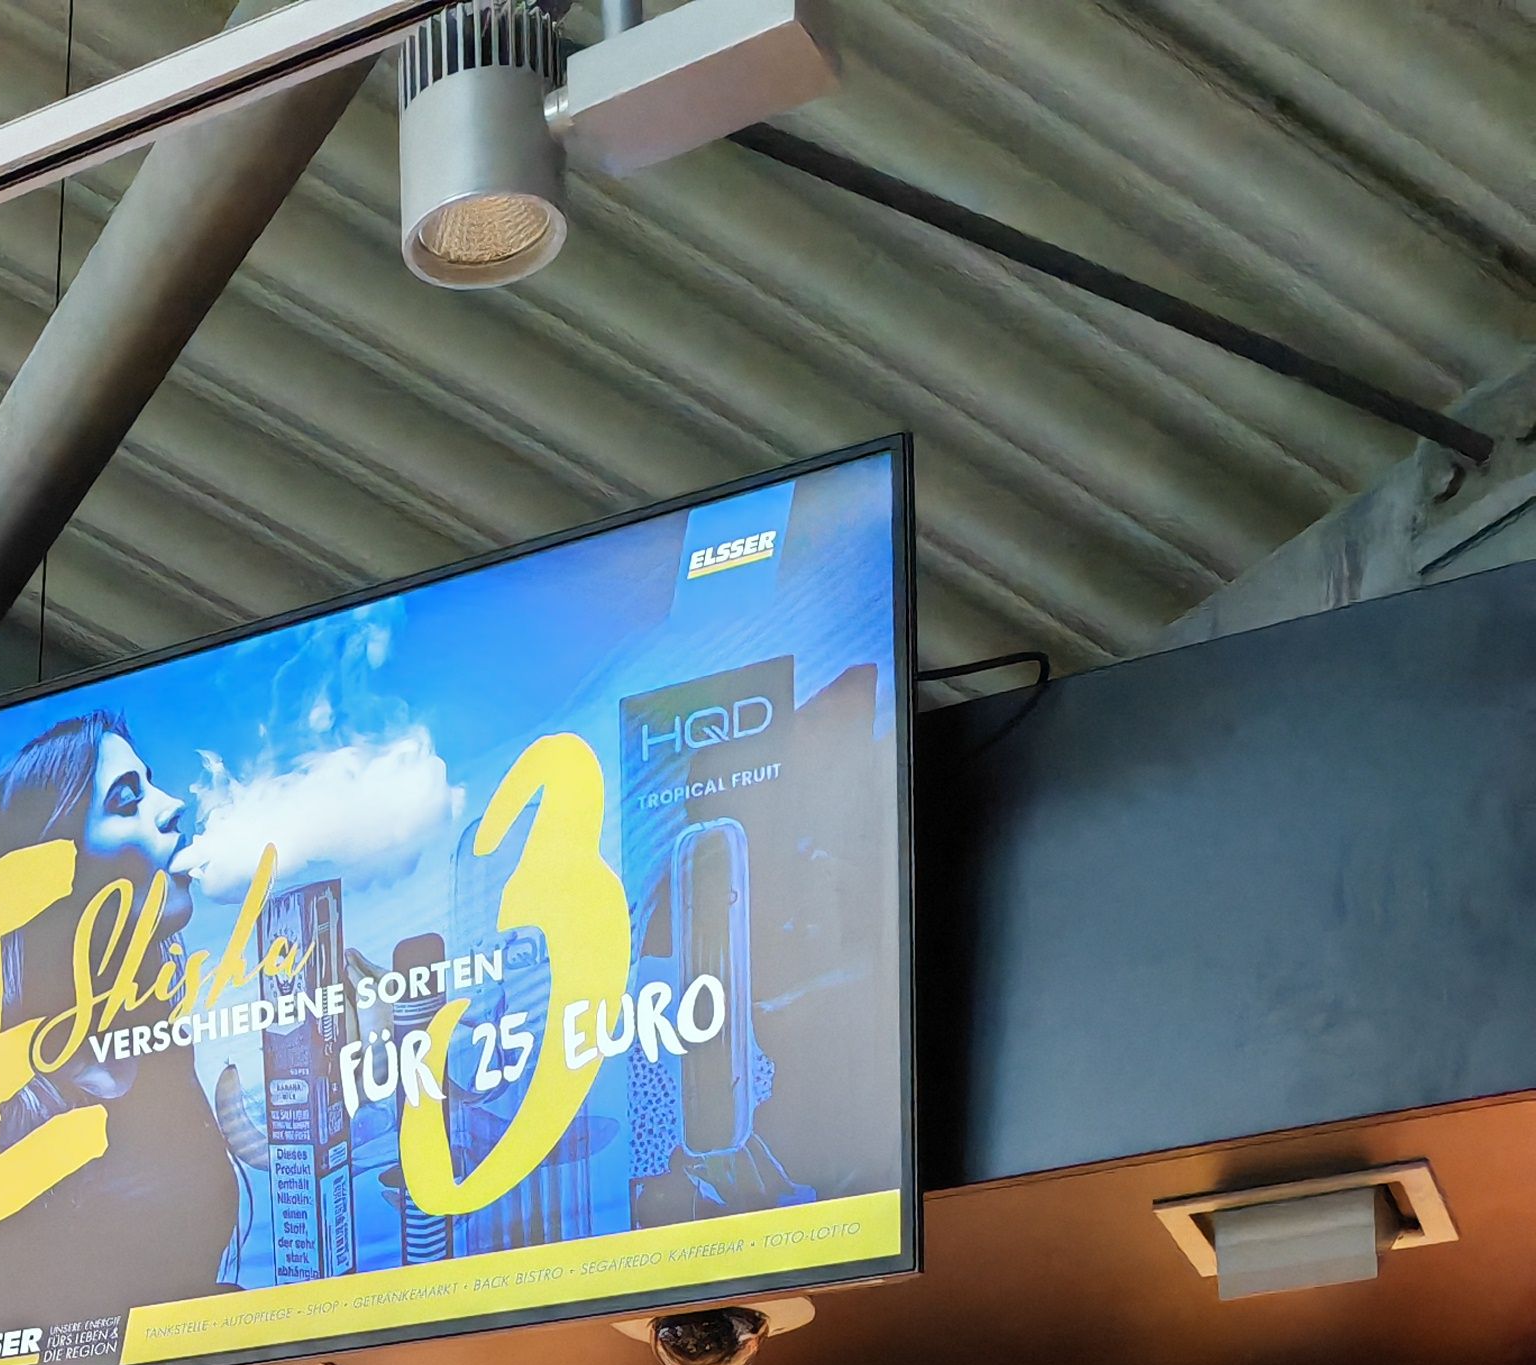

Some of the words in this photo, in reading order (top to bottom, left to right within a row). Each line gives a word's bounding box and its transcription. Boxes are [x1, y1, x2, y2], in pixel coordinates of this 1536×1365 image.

[689, 531, 777, 570] ELSSER
[642, 696, 773, 762] HQD
[636, 777, 725, 810] TROPICAL
[731, 763, 782, 788] FRUIT
[30, 842, 318, 1072] Shisha
[89, 982, 344, 1064] VERSCHIEDENE
[356, 950, 503, 1010] SORTEN
[339, 1031, 446, 1119] FÜR
[472, 1011, 534, 1091] 25
[562, 974, 726, 1071] EURO
[145, 1320, 209, 1341] TANKSTELLE
[223, 1307, 293, 1328] AUTOPFLEGE
[306, 1299, 339, 1317] SHOP
[352, 1280, 458, 1311] GETRÄNKEMARKT
[473, 1273, 510, 1292] BACK
[515, 1266, 564, 1286] BISTRO
[580, 1251, 662, 1276] SEGAFREDO
[668, 1238, 745, 1263] KAFFEEBAR
